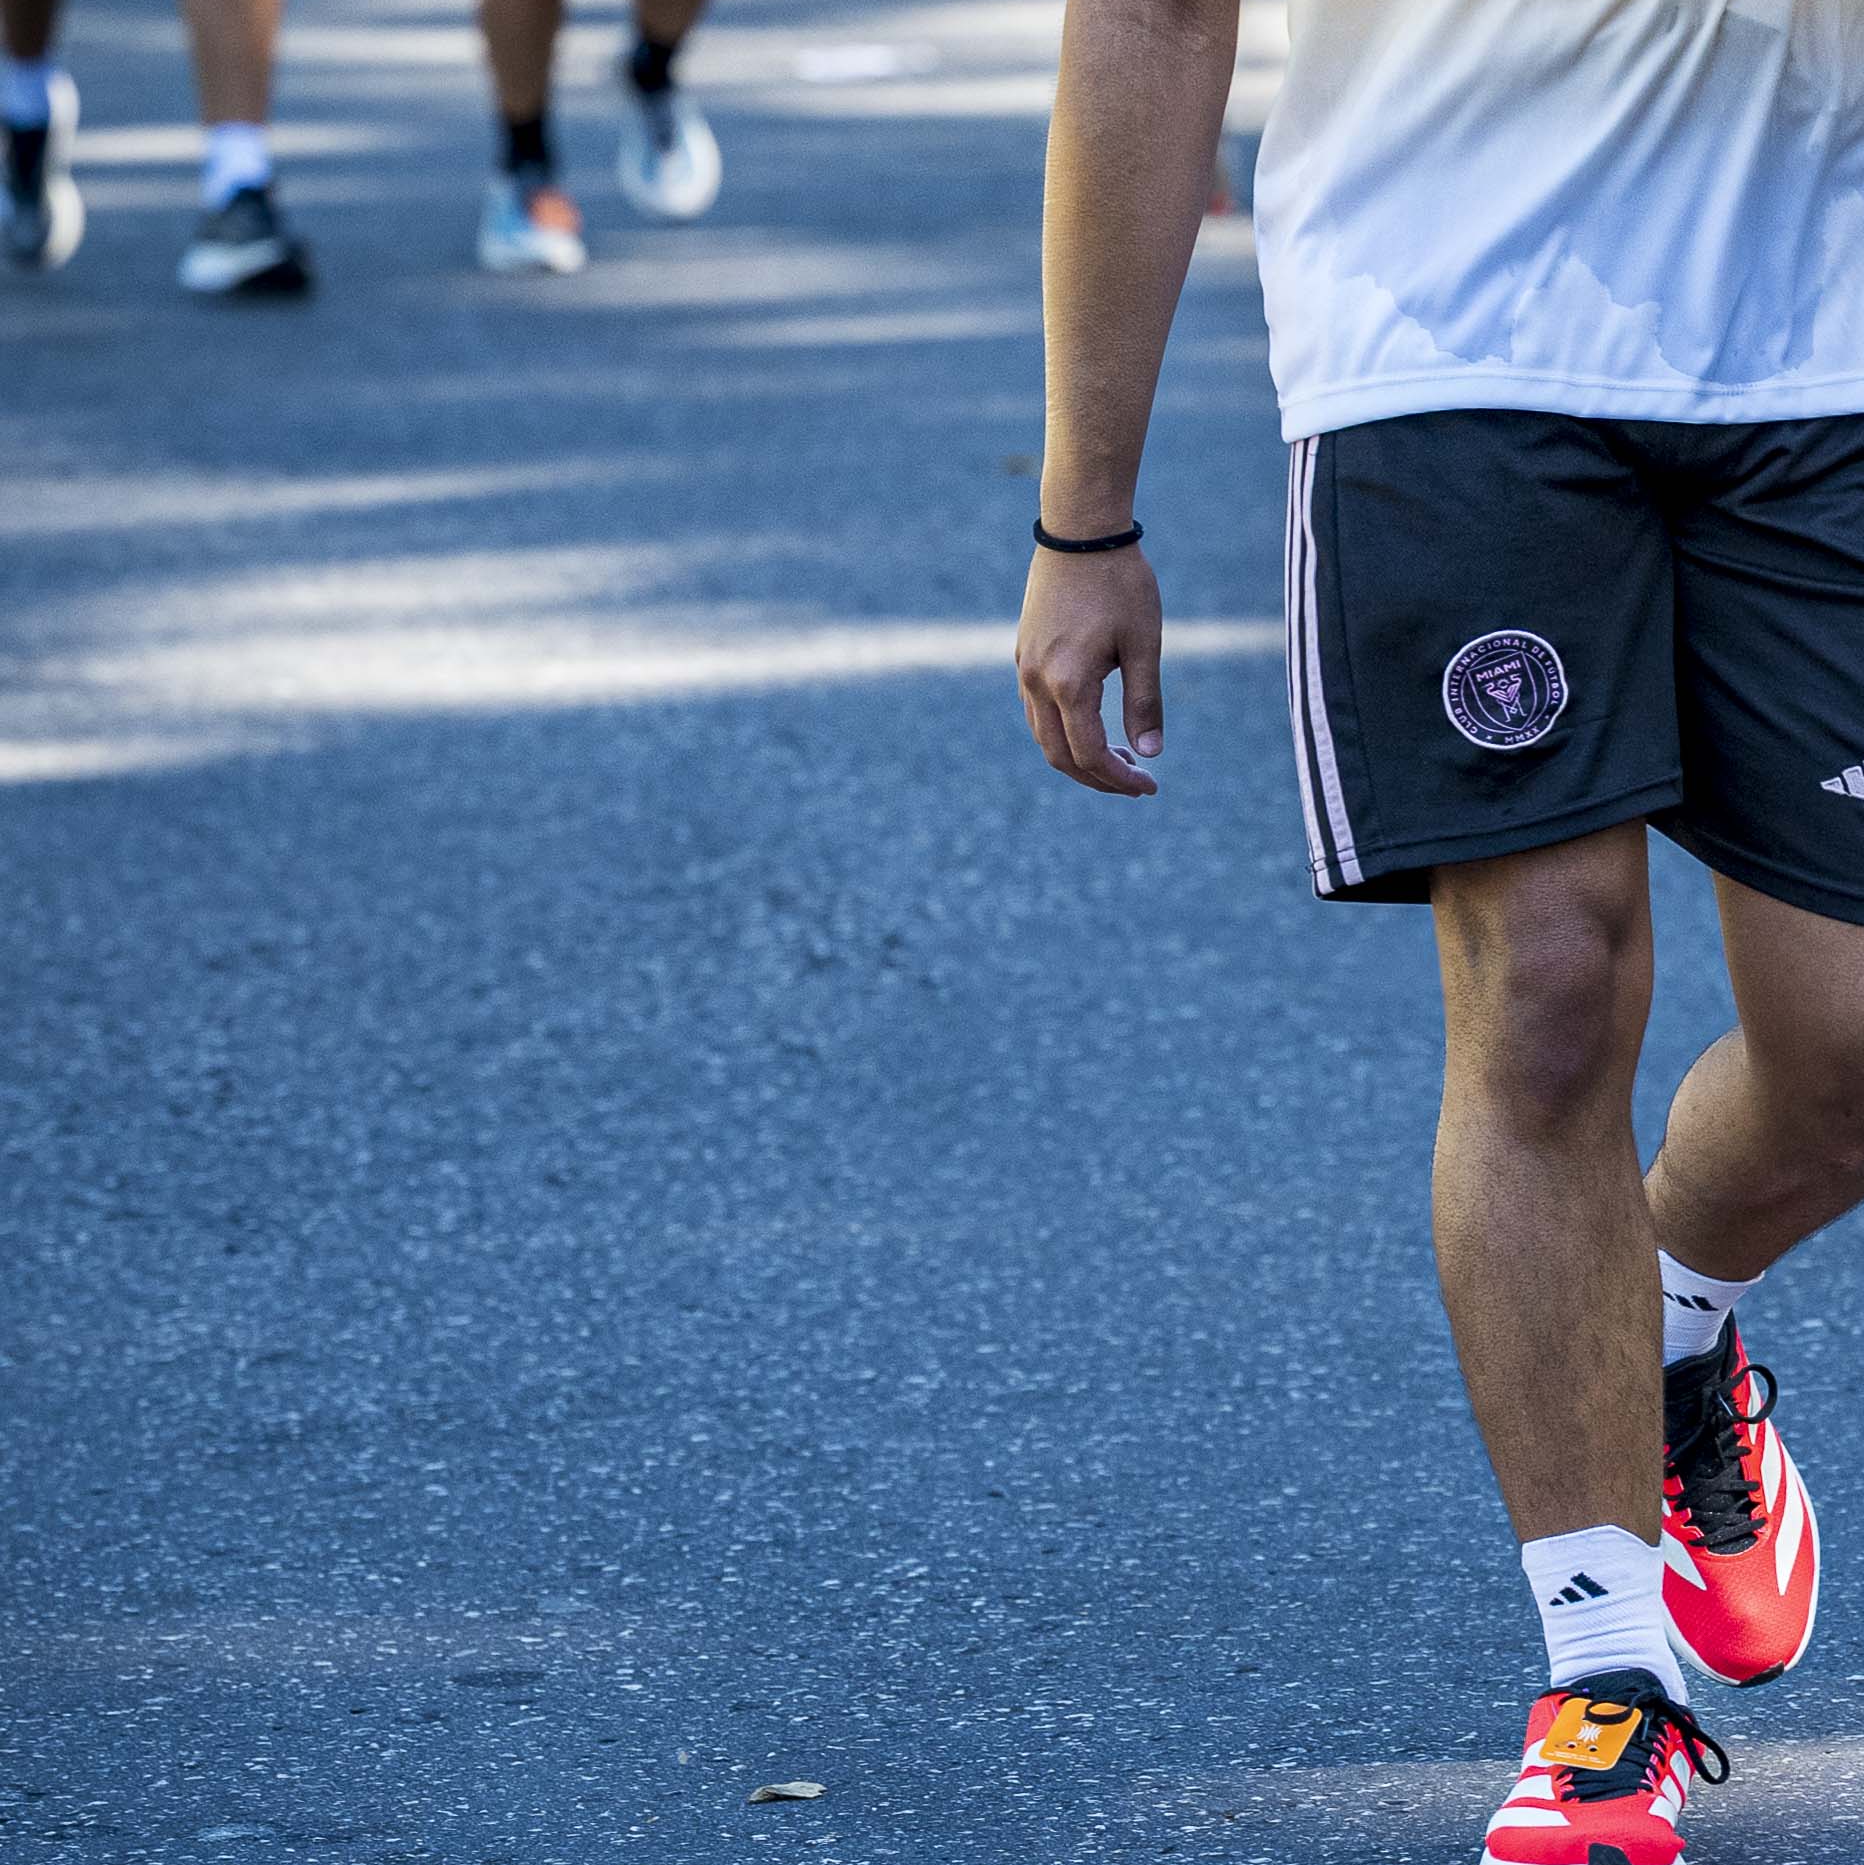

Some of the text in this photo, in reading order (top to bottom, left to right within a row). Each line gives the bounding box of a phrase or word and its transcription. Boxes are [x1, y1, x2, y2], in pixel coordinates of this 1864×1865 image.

[1531, 645, 1545, 659] DE
[1450, 638, 1527, 702] INTERNACIONAL
[1475, 659, 1522, 682] MIAMI
[1454, 707, 1479, 734] CLUB
[1504, 725, 1541, 744] MMXX
